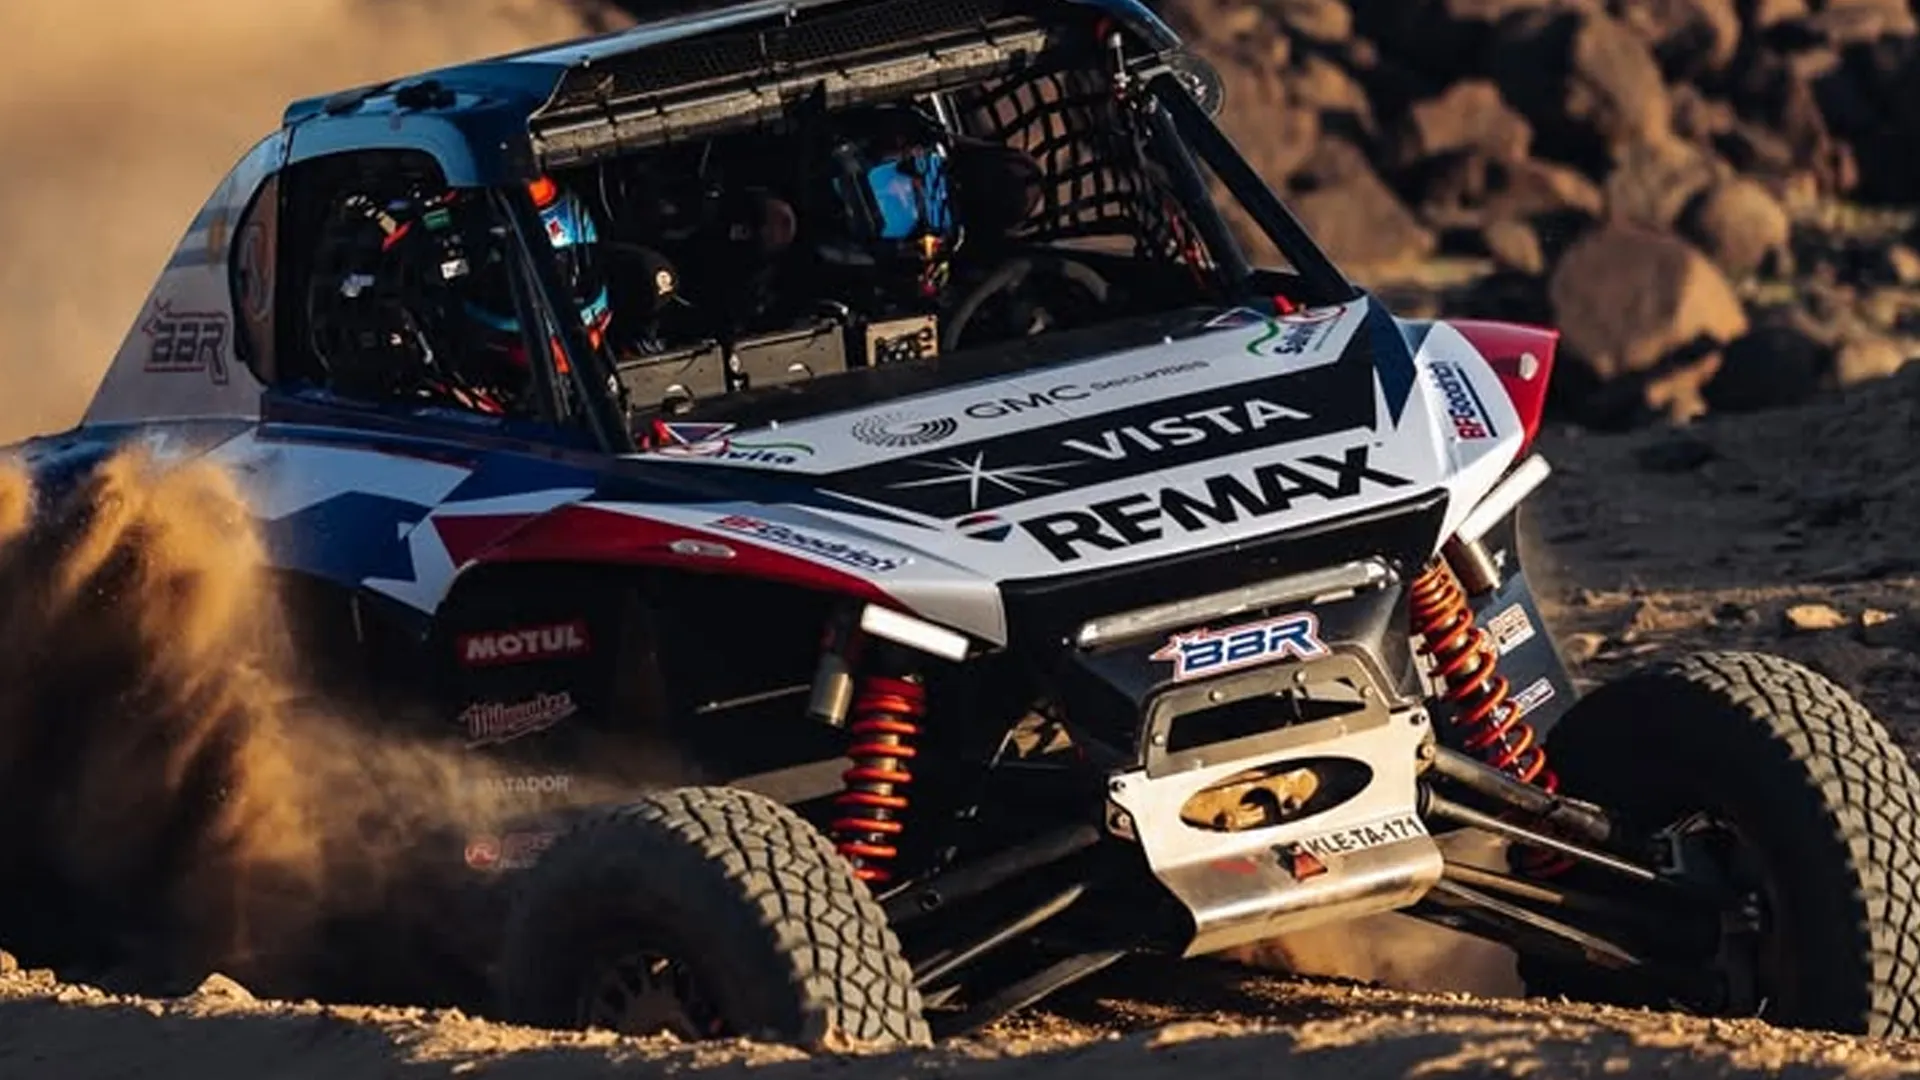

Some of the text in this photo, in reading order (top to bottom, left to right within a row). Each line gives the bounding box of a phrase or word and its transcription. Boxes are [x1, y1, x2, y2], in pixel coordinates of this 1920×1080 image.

[963, 384, 1091, 419] GMC
[1061, 399, 1312, 462] VISTA
[1020, 445, 1415, 563] REMAX
[466, 625, 583, 660] MOTUL
[1178, 618, 1318, 672] BBR
[1305, 817, 1422, 856] KLE-TA-171
